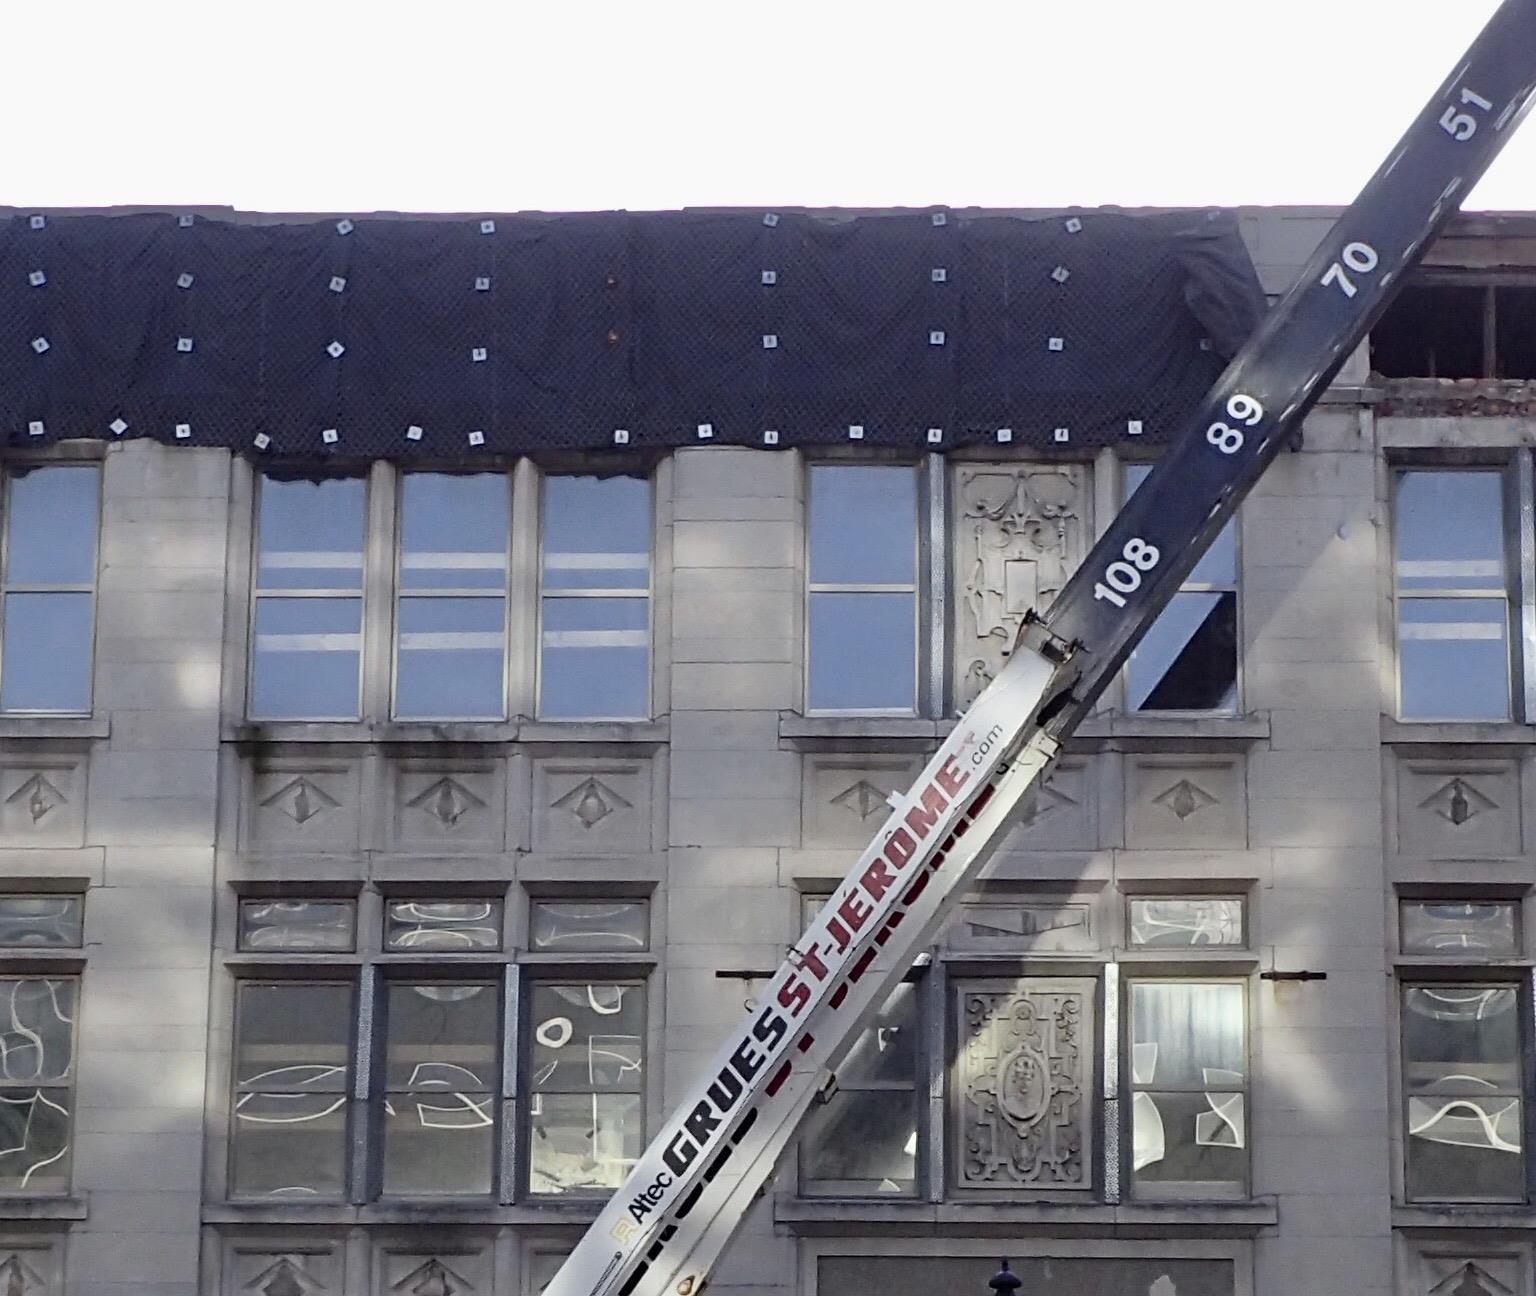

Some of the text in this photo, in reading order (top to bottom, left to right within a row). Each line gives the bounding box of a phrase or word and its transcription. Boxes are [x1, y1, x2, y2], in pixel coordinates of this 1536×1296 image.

[1438, 87, 1493, 141] 51
[1320, 241, 1379, 298] 70
[1206, 393, 1264, 455] 89
[1093, 537, 1160, 608] 108
[628, 1172, 673, 1225] Altec
[662, 1006, 788, 1178] GRUES
